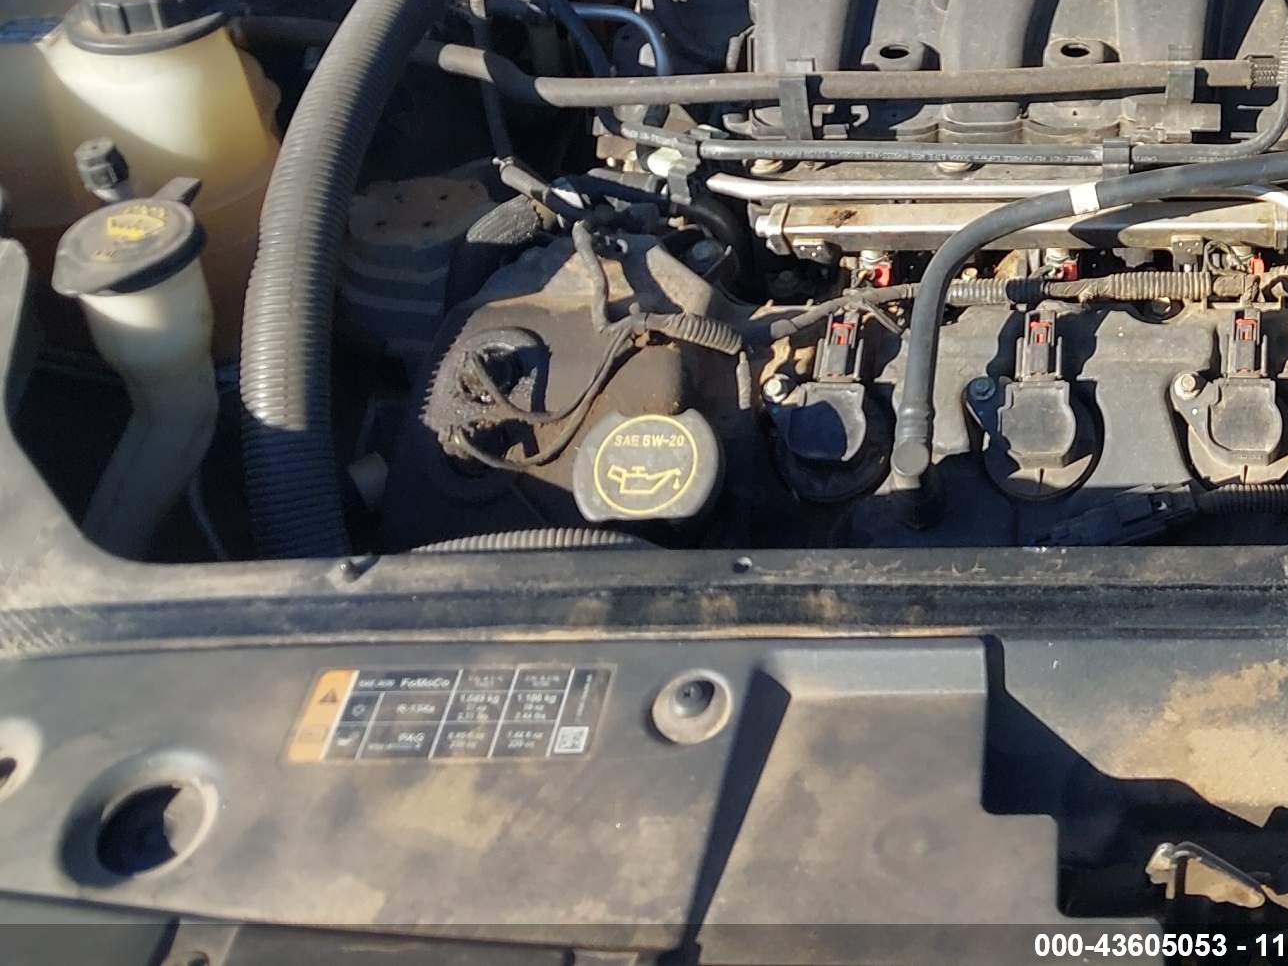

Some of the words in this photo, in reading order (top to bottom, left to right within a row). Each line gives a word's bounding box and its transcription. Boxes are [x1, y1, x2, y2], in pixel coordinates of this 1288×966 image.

[614, 434, 640, 447] SAE
[642, 434, 684, 447] 5W-20
[400, 677, 451, 688] FoMoCo
